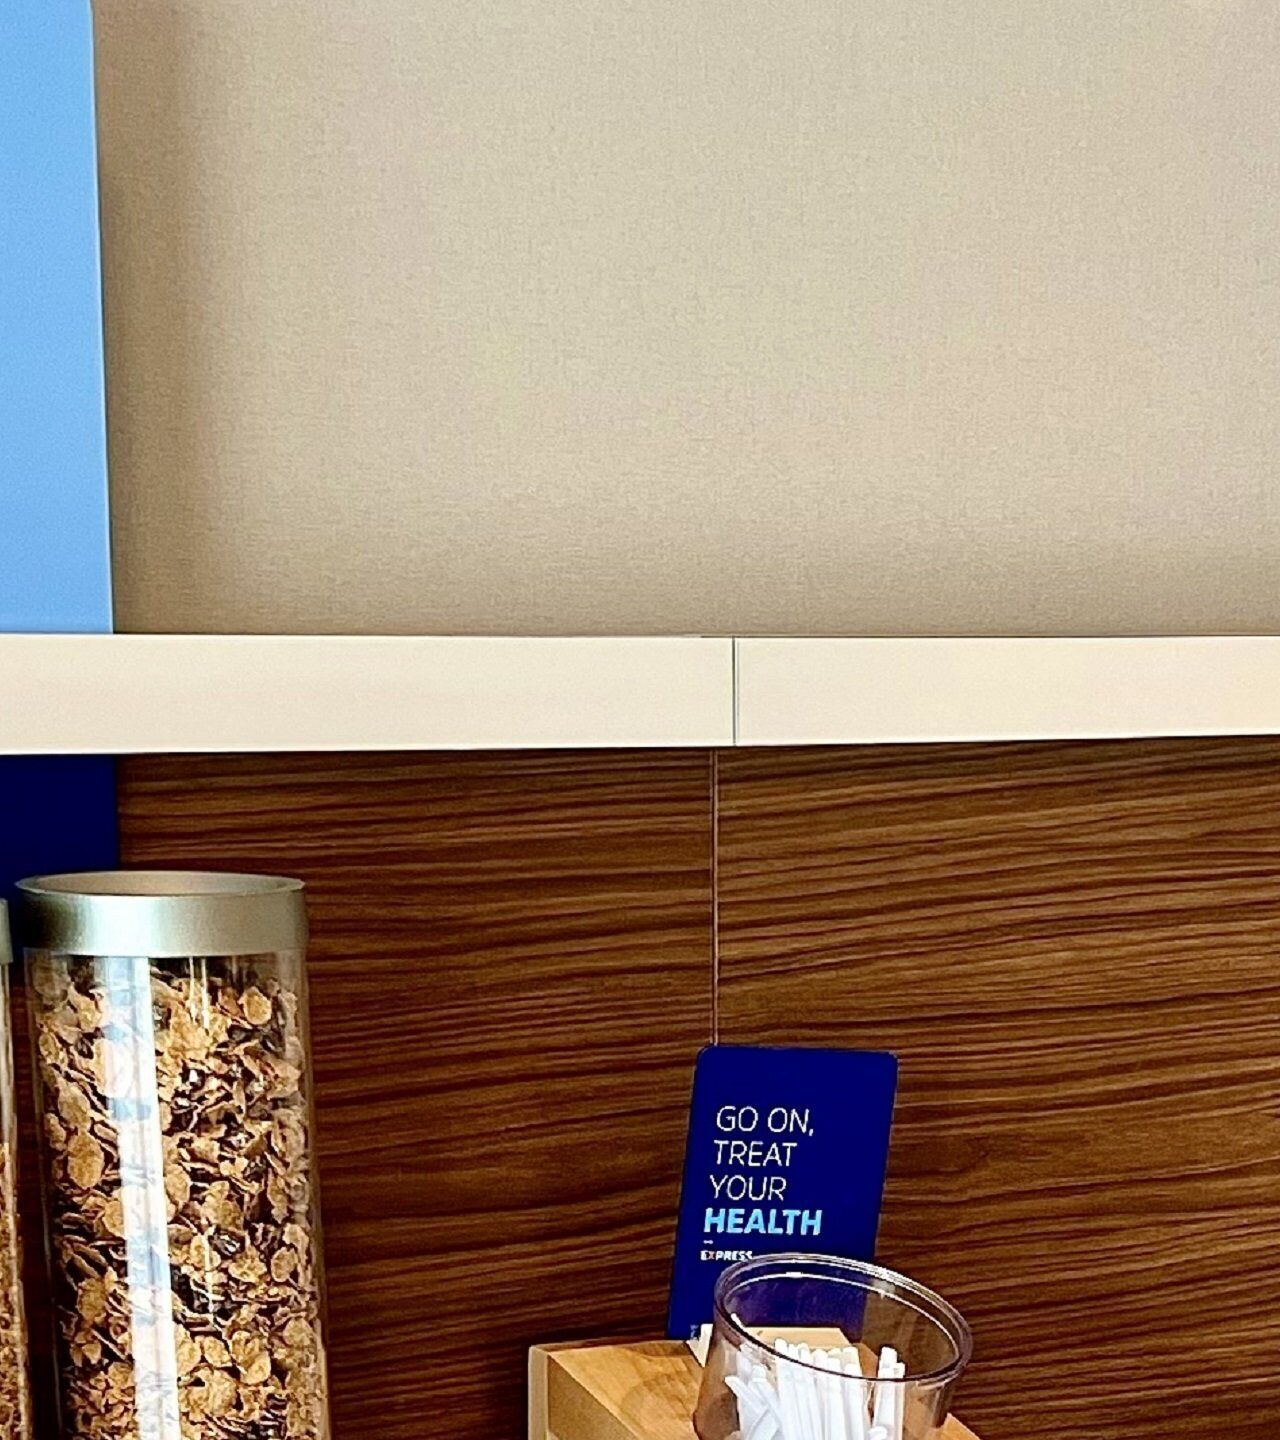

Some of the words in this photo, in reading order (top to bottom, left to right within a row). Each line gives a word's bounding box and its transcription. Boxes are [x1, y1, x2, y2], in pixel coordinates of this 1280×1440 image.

[715, 1104, 759, 1133] GO
[766, 1106, 815, 1137] ON,
[712, 1138, 799, 1168] TREAT
[708, 1173, 788, 1202] YOUR
[702, 1206, 824, 1237] HEALTH
